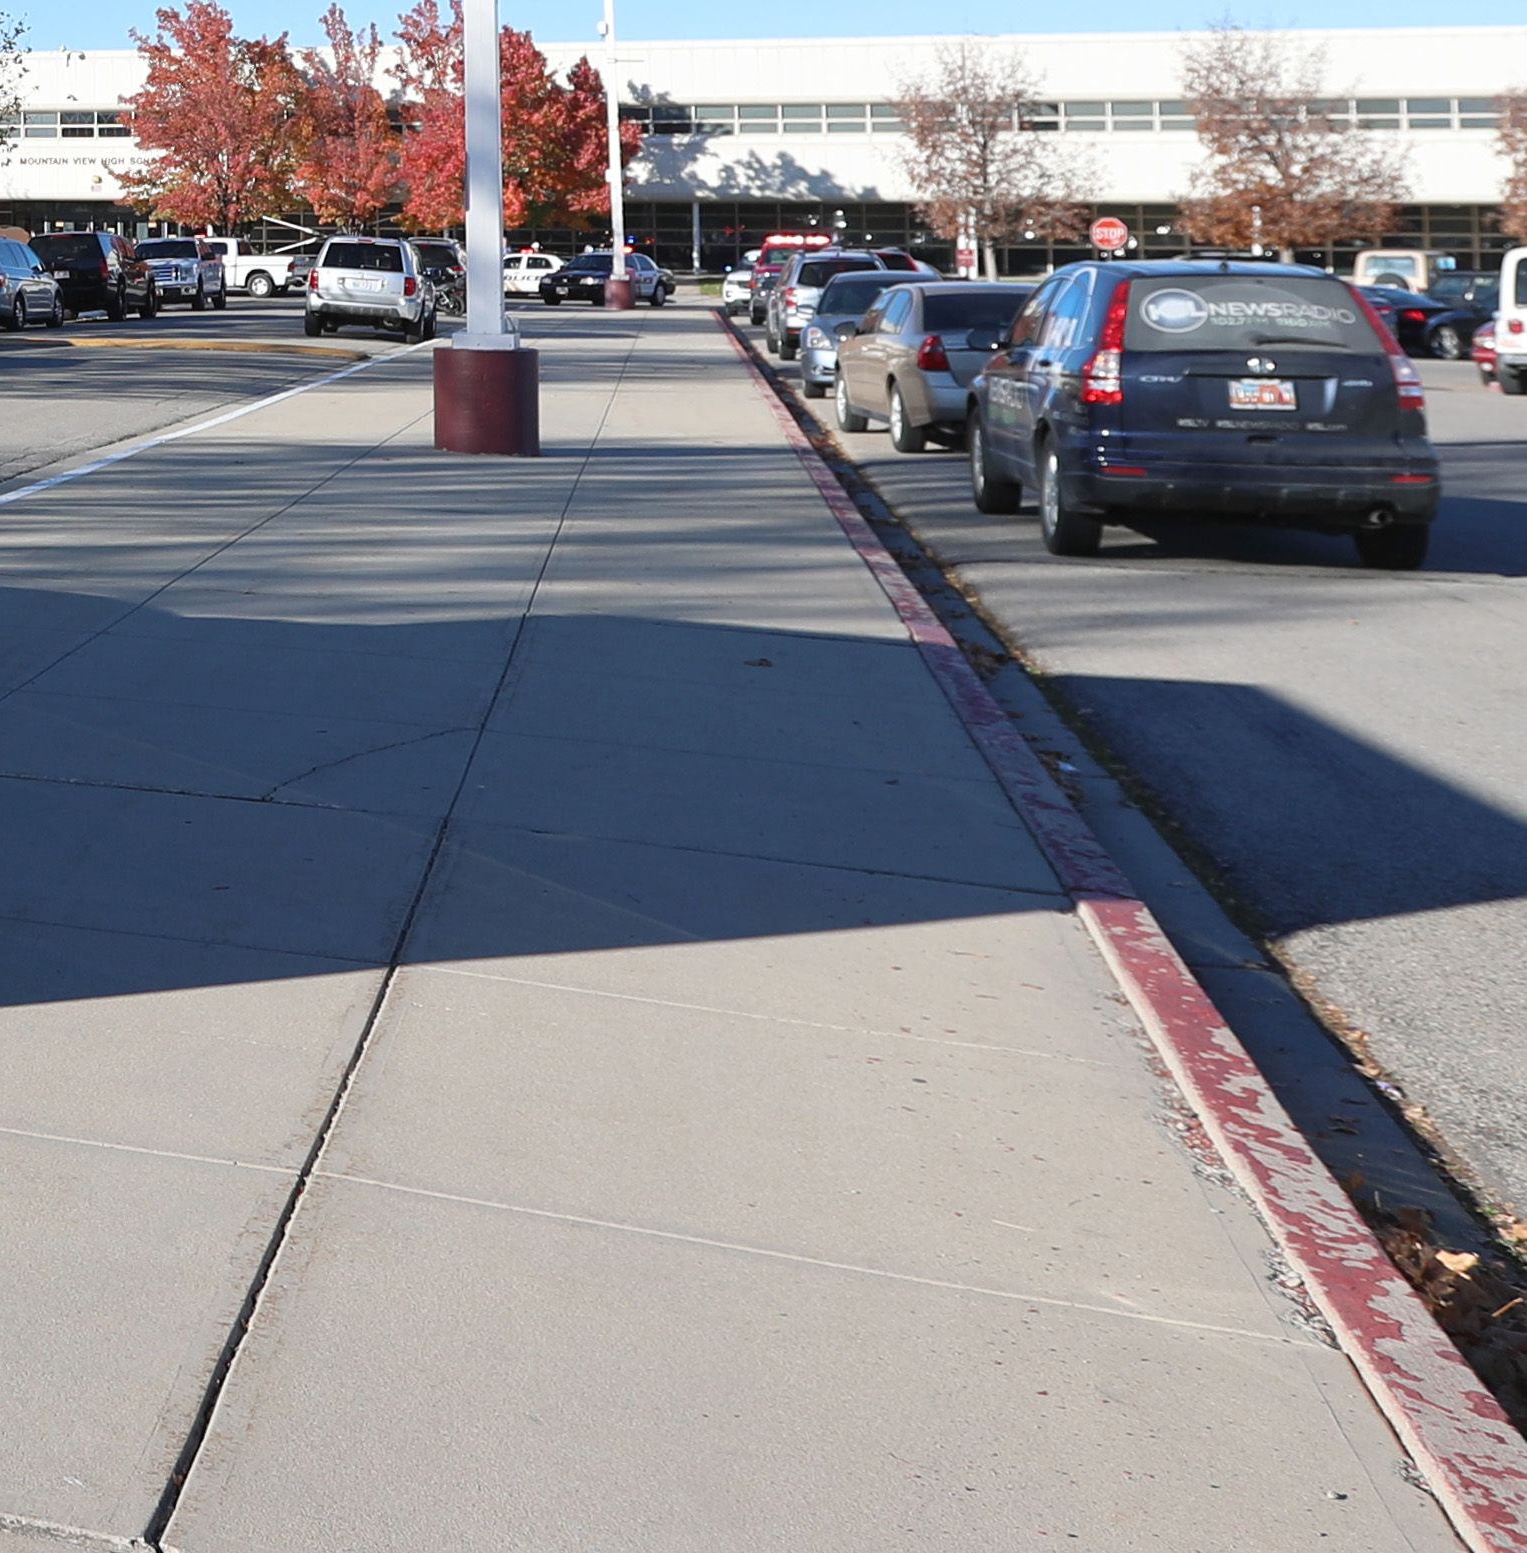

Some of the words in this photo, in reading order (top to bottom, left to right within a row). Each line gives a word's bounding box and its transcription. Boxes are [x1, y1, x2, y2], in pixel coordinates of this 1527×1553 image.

[20, 157, 68, 165] MOUNTAIN
[73, 157, 96, 165] VIEW
[101, 157, 125, 165] HIGH
[1096, 228, 1125, 239] STOP
[1209, 302, 1356, 324] NEWSRADIO
